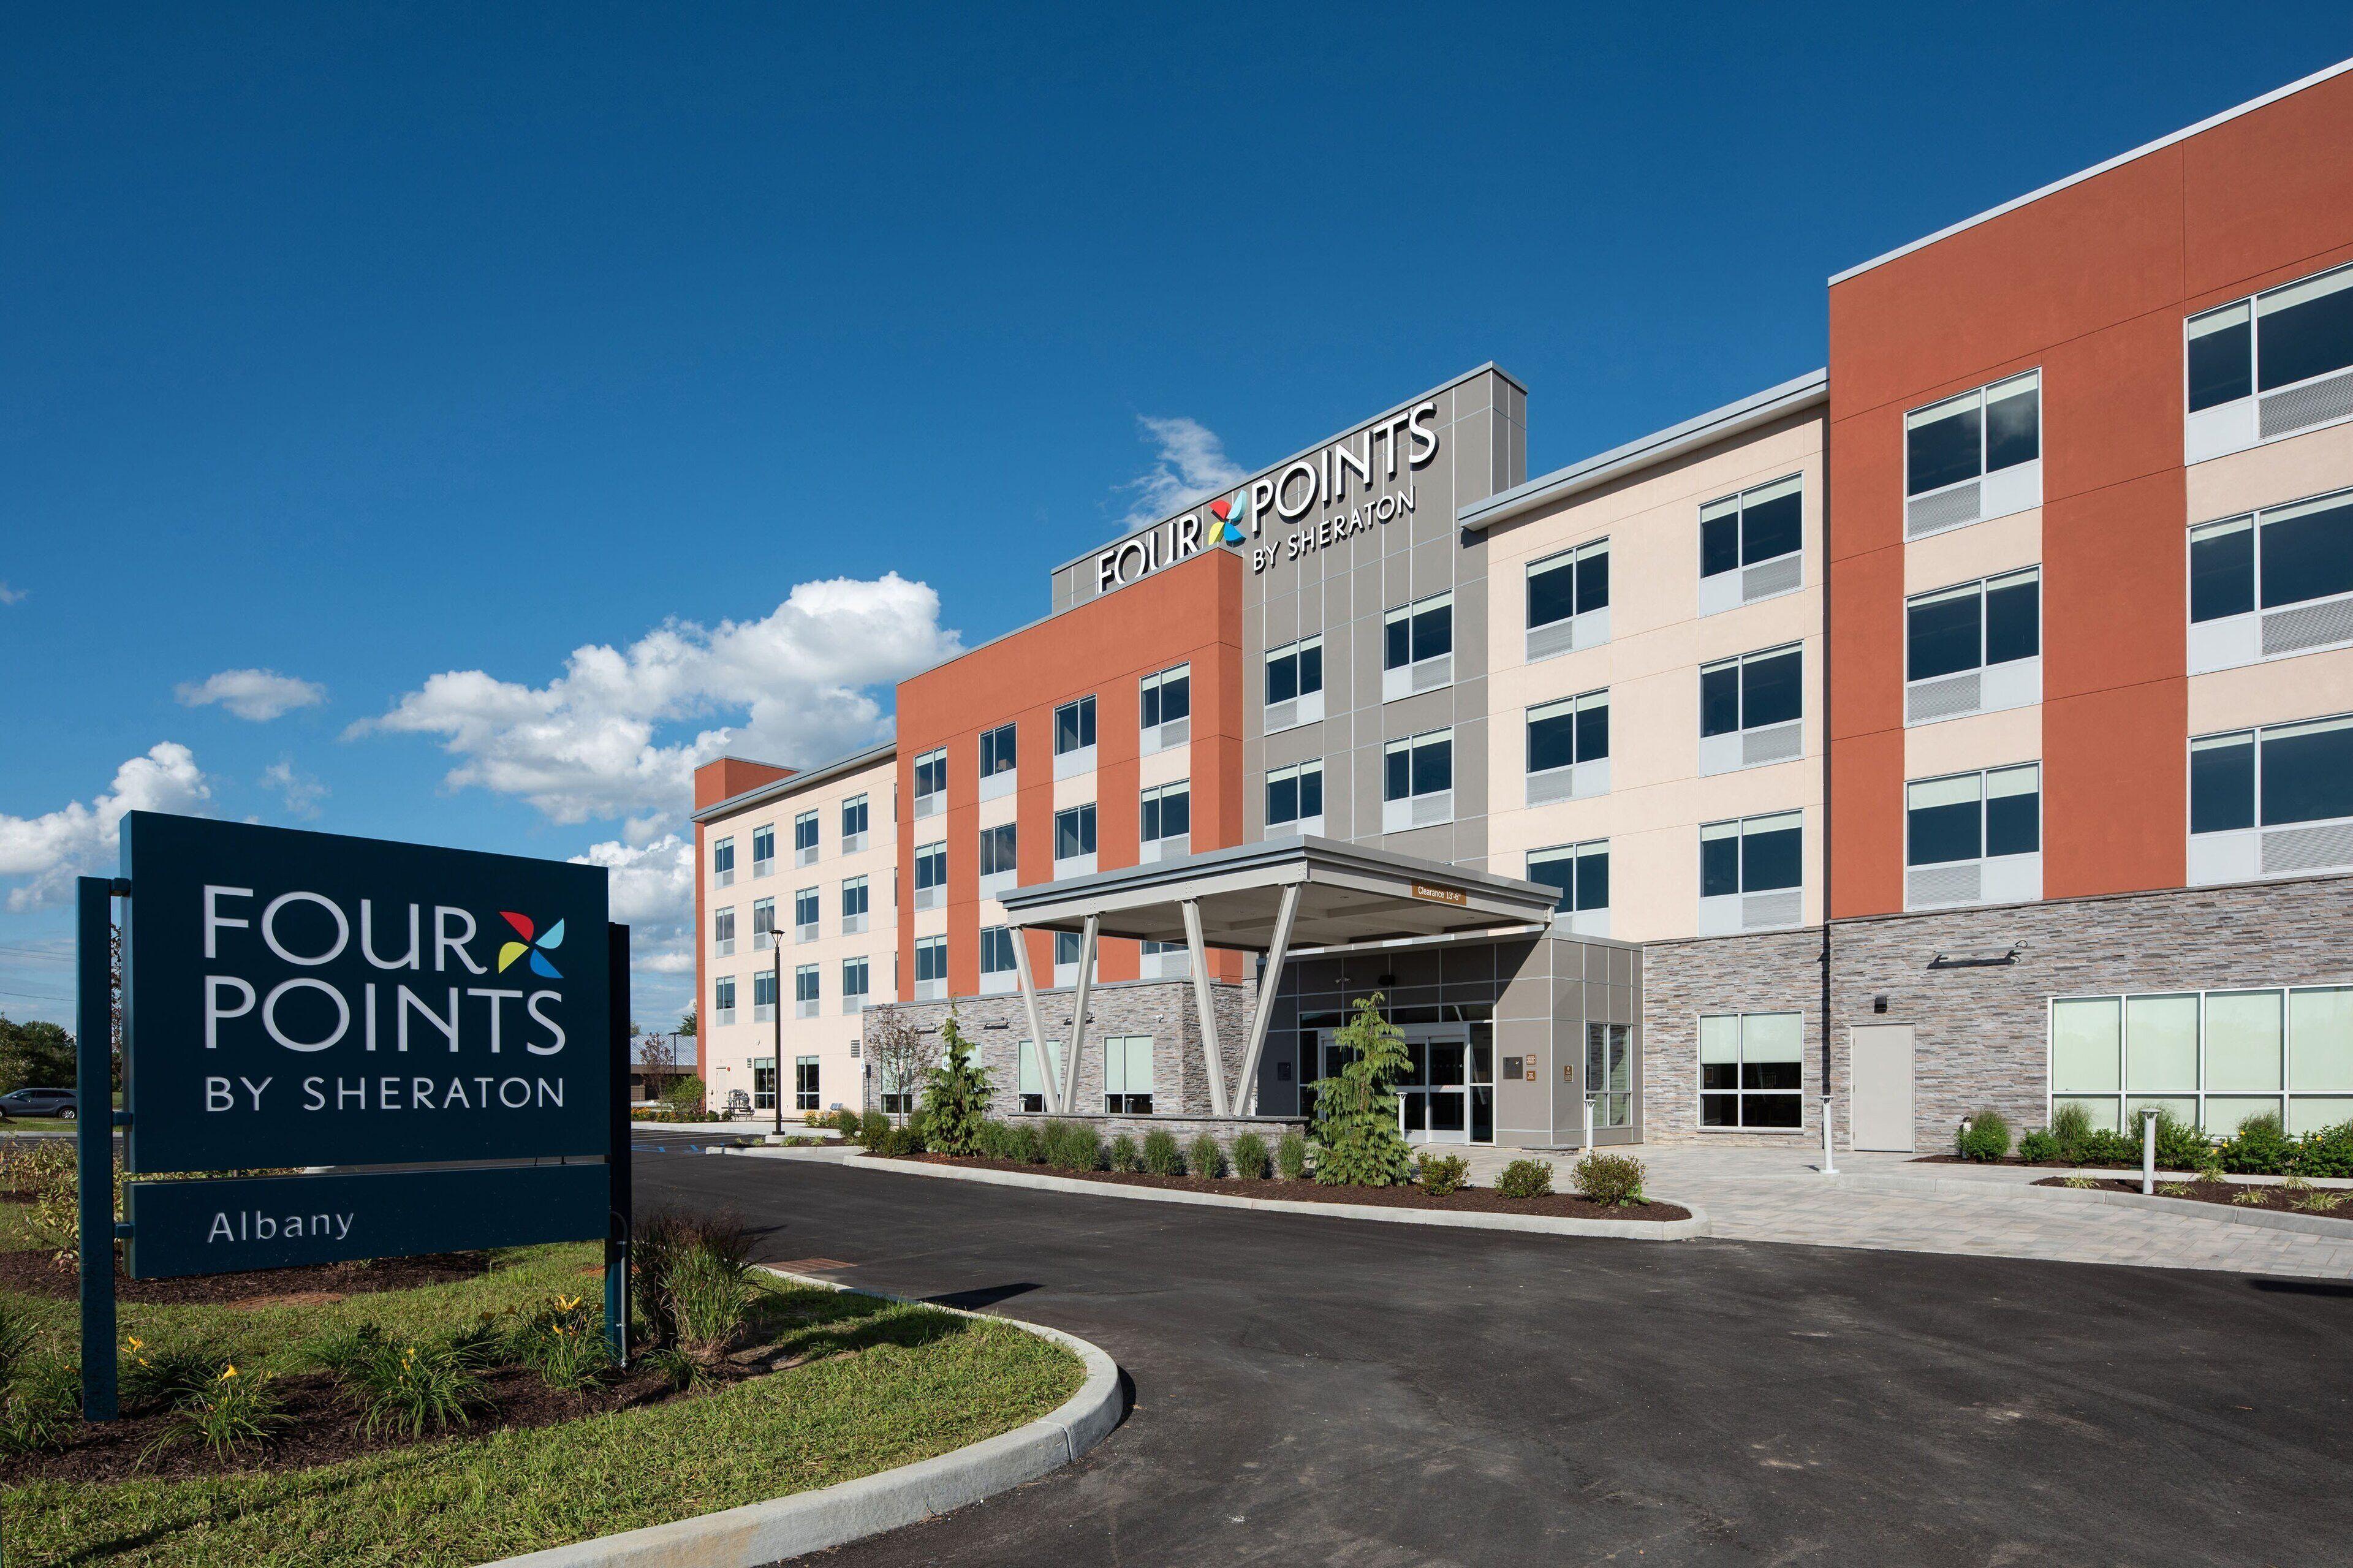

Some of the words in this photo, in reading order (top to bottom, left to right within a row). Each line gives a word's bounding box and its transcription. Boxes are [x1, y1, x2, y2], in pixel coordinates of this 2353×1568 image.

[1098, 513, 1202, 594] FOUR
[1252, 401, 1439, 534] POINTS
[1254, 540, 1281, 575] BY
[1287, 485, 1417, 562] SHERATON
[203, 884, 488, 974] FOUR
[1418, 885, 1444, 899] Clearance
[205, 975, 566, 1056] POINTS
[205, 1077, 273, 1112] BY
[303, 1077, 564, 1111] SHERATON
[207, 1211, 354, 1243] Albany
